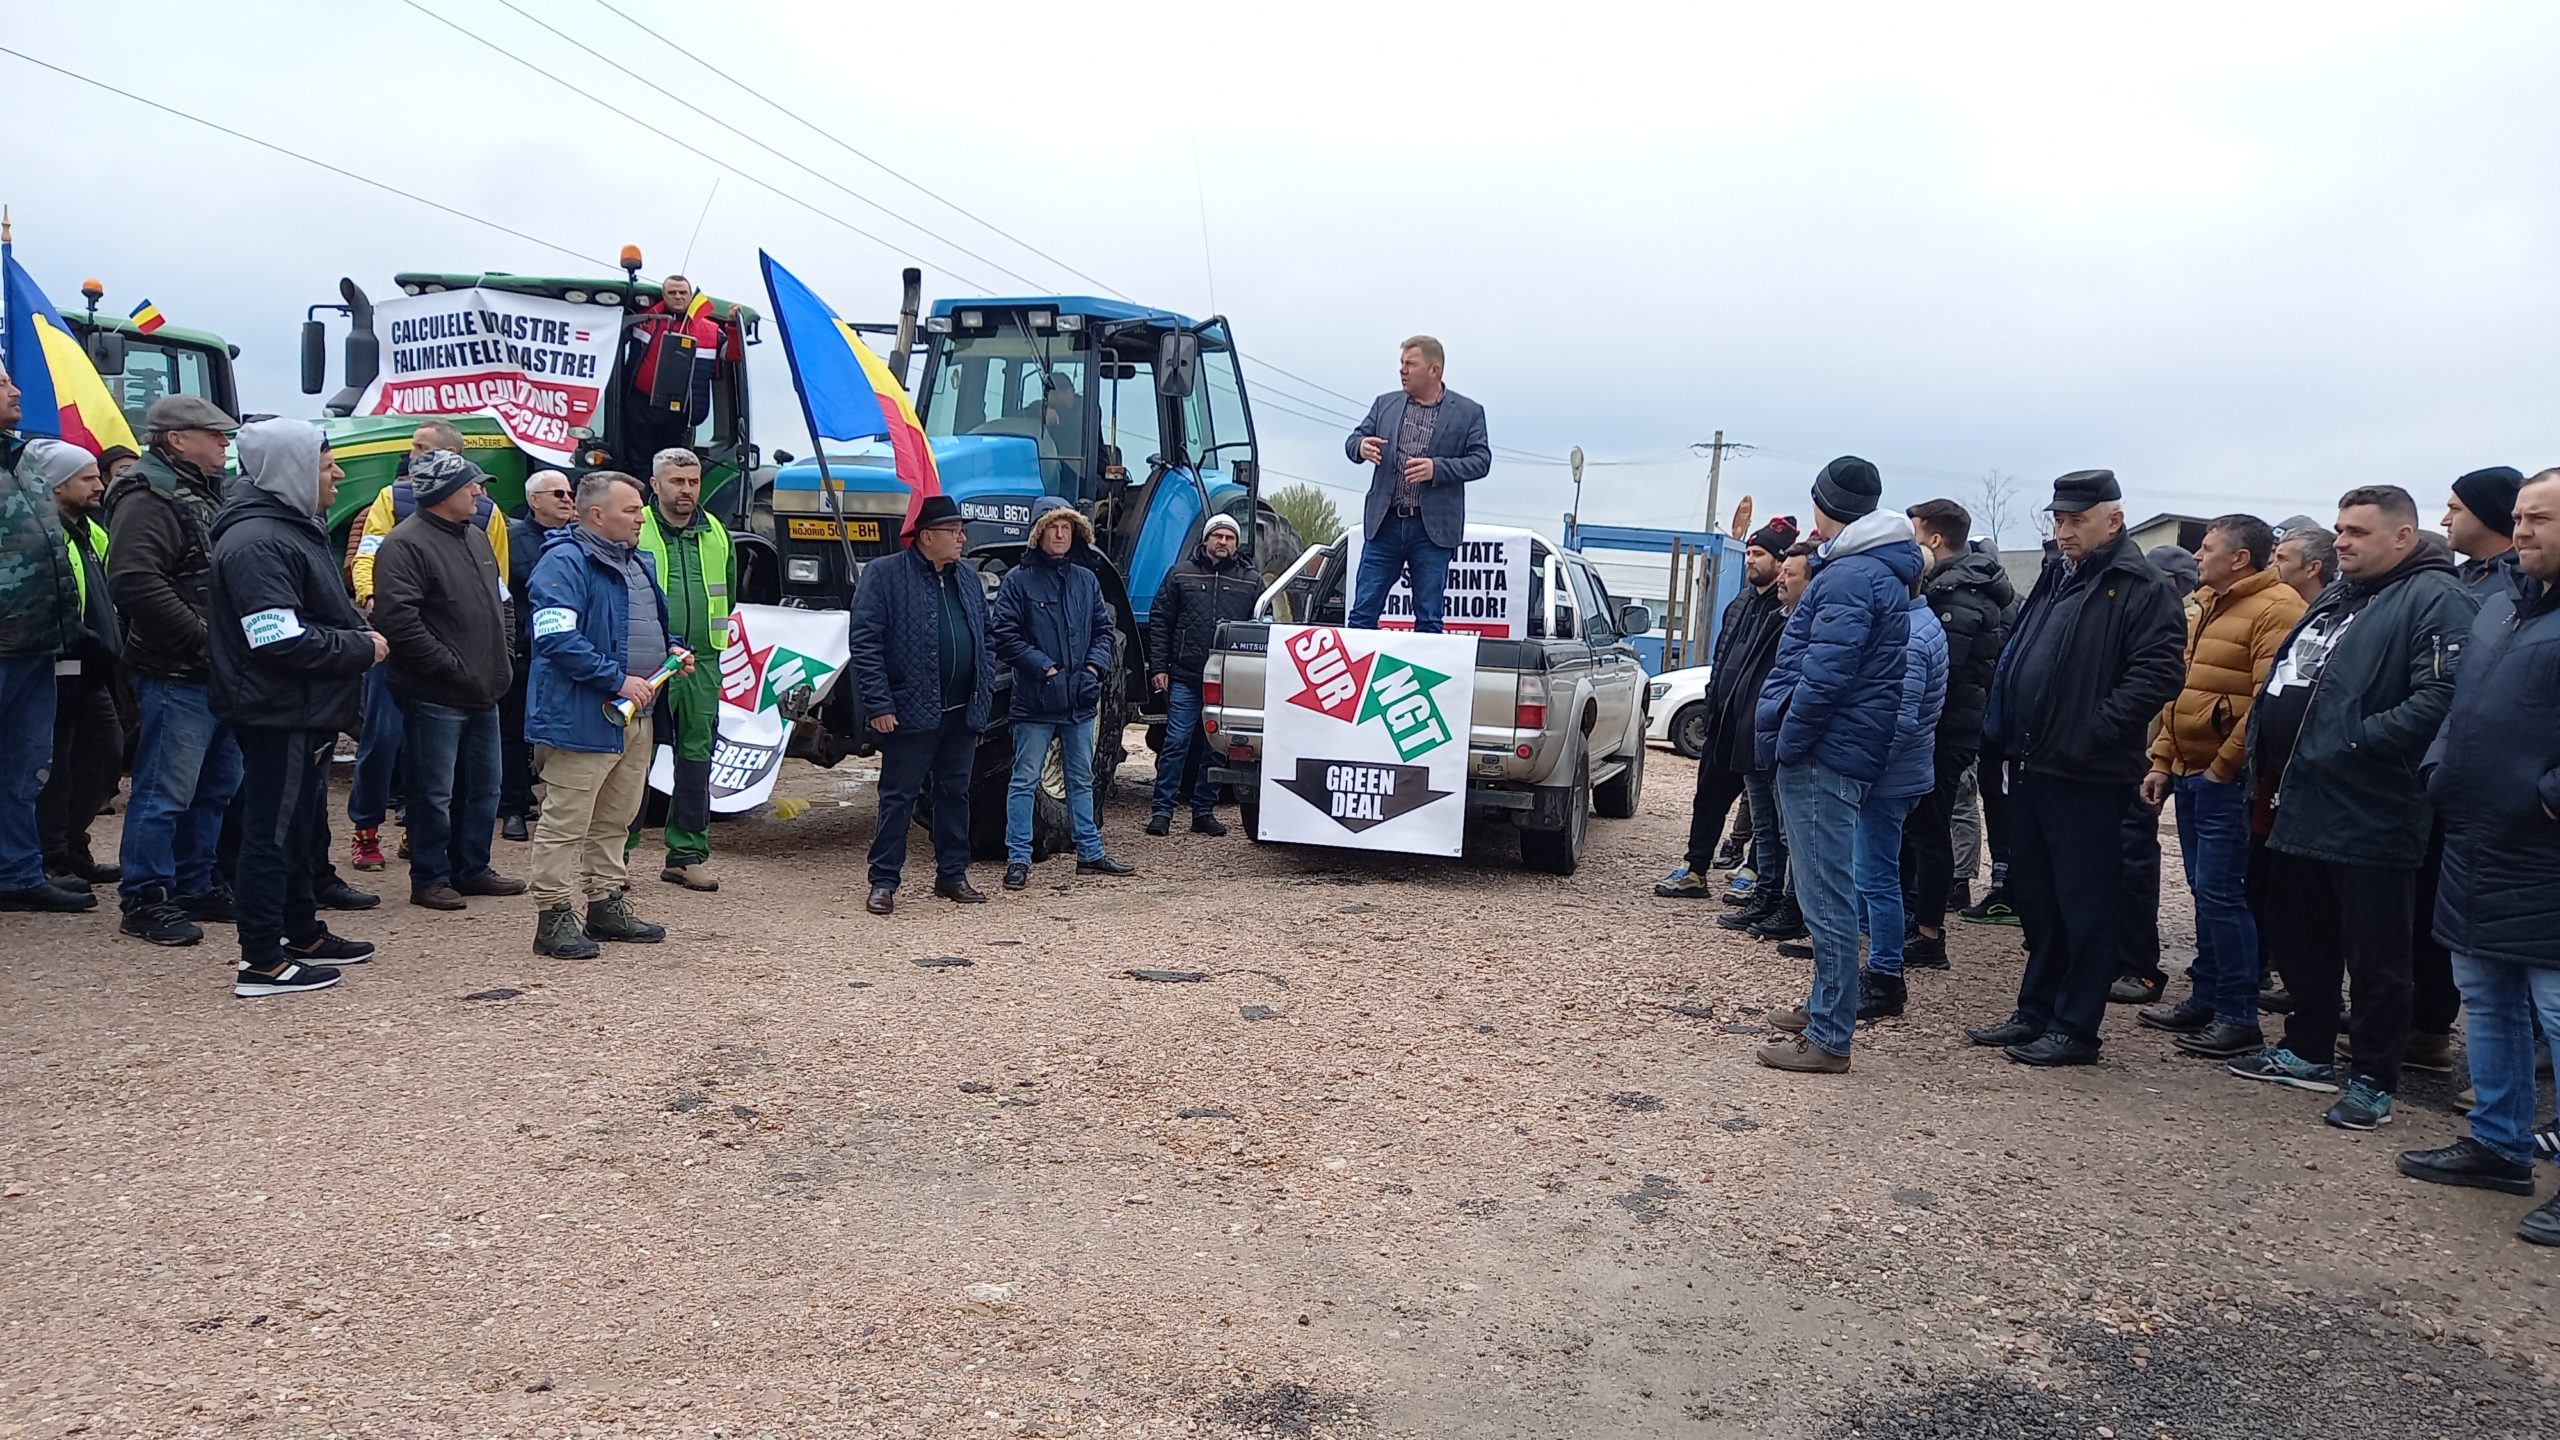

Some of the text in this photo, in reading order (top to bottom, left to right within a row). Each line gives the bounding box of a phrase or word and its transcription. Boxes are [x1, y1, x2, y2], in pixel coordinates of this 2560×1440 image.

[391, 311, 477, 344] CALCULELE
[393, 340, 503, 374] FALIMENTELE
[393, 386, 438, 412] YOUR
[975, 504, 999, 519] HOLLAND
[1004, 504, 1030, 522] 8670
[792, 527, 825, 536] NOJORID
[1004, 527, 1020, 535] FORD
[1295, 628, 1357, 711] SUR
[1371, 665, 1446, 753] NGT
[711, 739, 773, 770] GREEN
[1326, 765, 1396, 796] GREEN
[1331, 794, 1384, 821] DEAL
